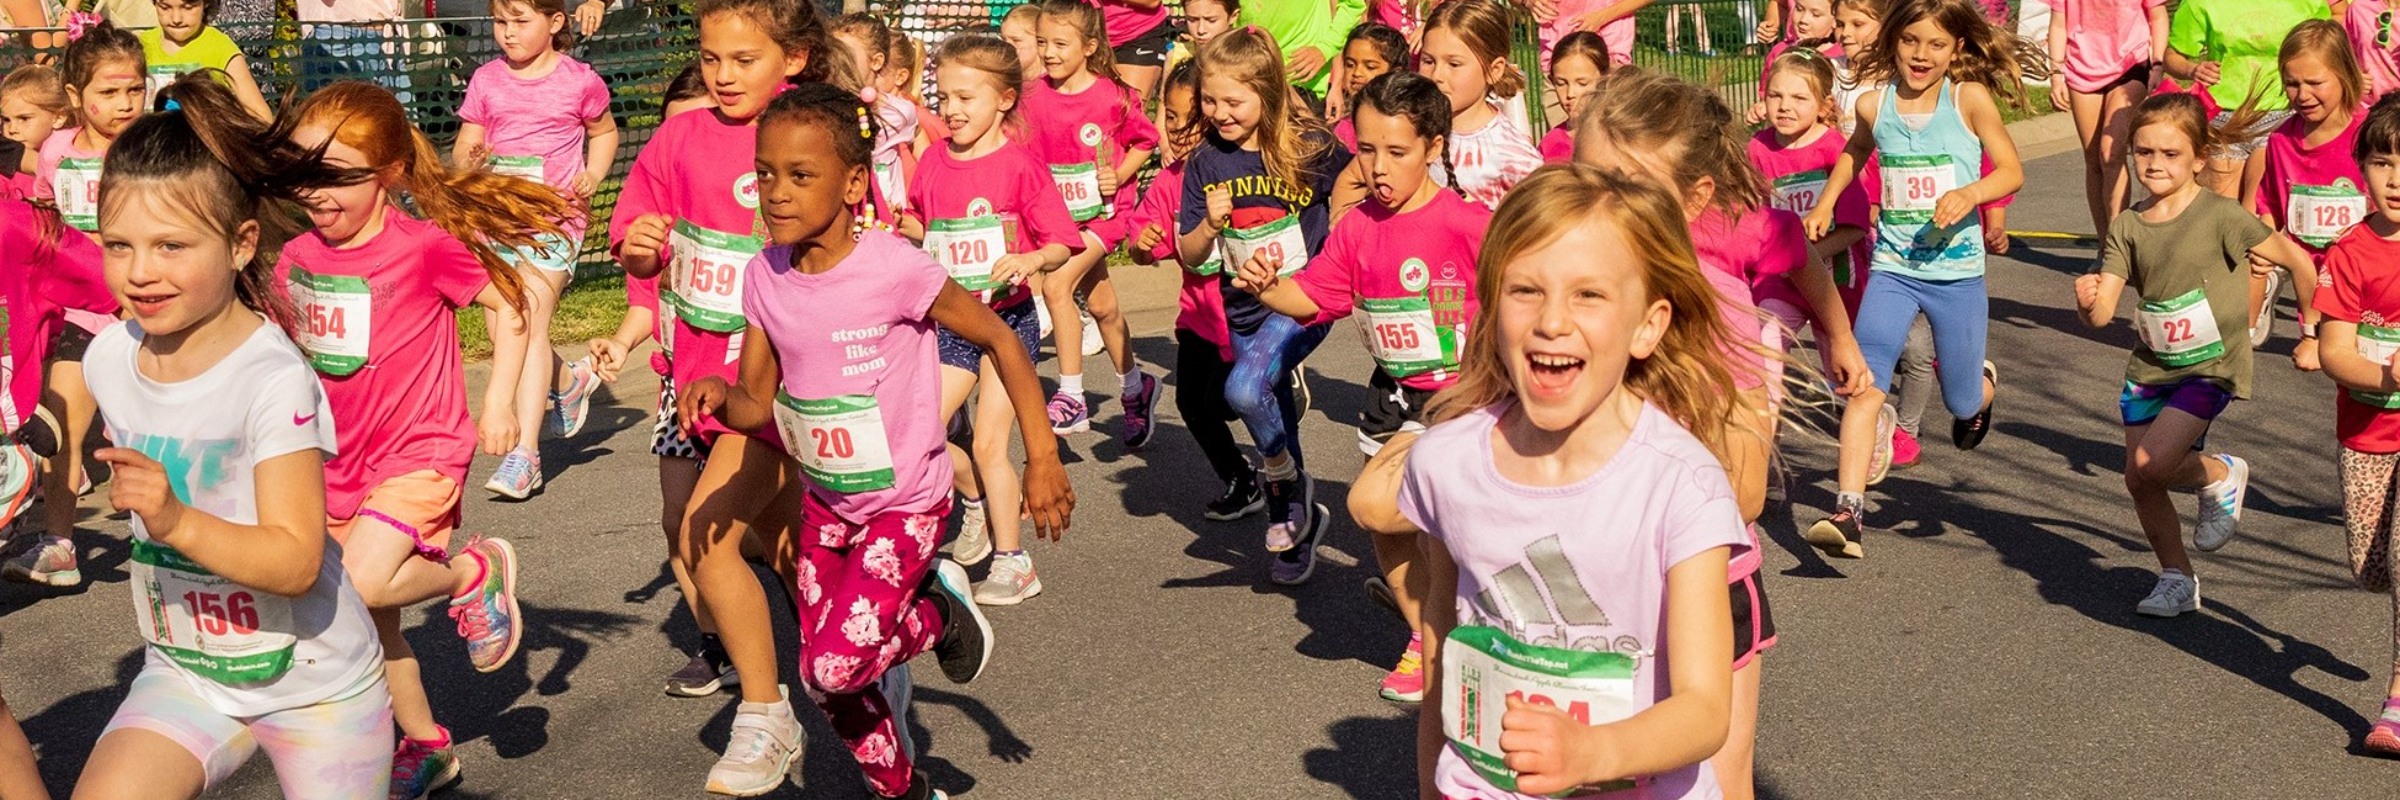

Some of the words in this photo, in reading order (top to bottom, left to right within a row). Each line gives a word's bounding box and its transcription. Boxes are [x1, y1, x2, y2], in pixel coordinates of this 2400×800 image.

[1057, 182, 1087, 201] 186
[1908, 176, 1936, 200] 39
[1788, 190, 1815, 212] 112
[2314, 205, 2351, 226] 128
[949, 239, 988, 265] 120
[690, 257, 737, 296] 159
[305, 303, 346, 339] 154
[831, 324, 888, 342] strong
[2163, 318, 2195, 343] 22
[1376, 323, 1420, 350] 155
[845, 344, 877, 359] like
[841, 356, 887, 377] mom
[811, 427, 854, 458] 20
[183, 590, 260, 636] 156
